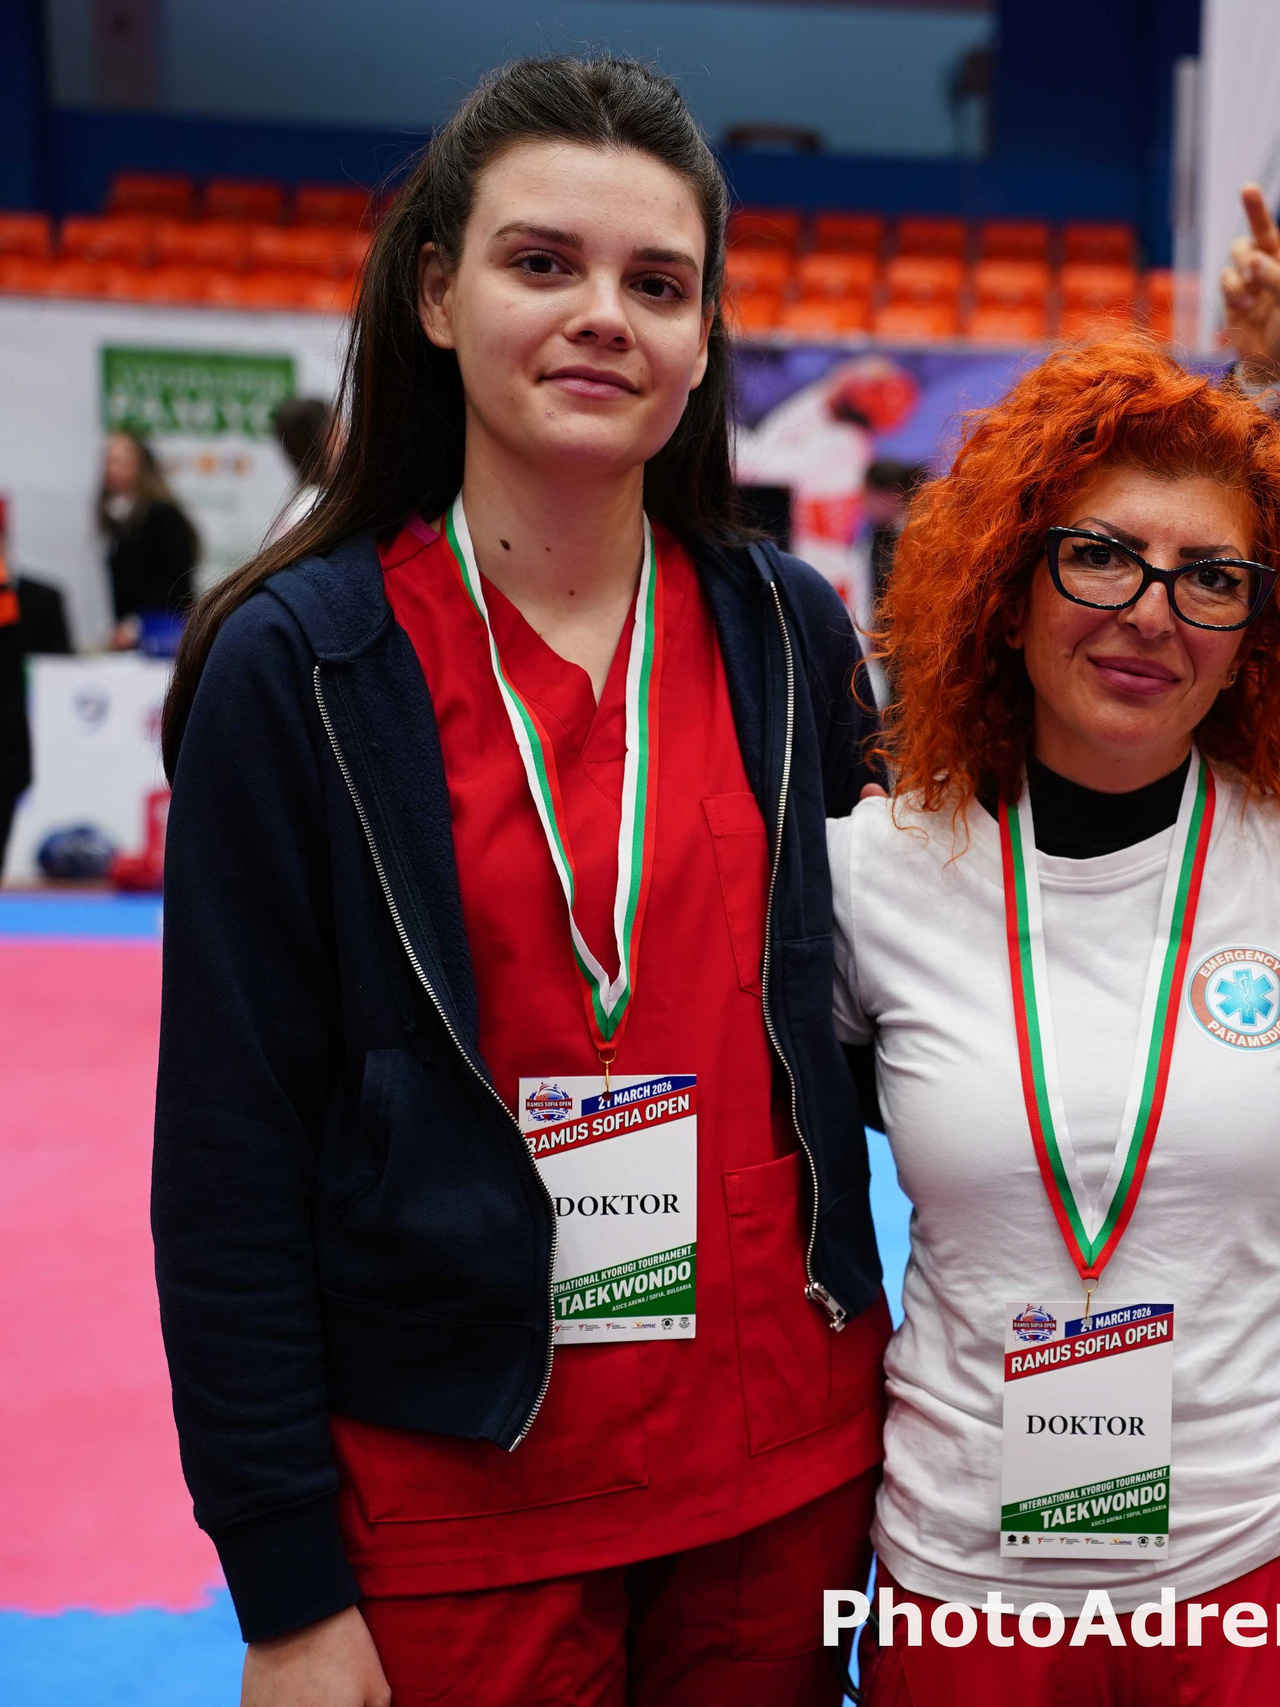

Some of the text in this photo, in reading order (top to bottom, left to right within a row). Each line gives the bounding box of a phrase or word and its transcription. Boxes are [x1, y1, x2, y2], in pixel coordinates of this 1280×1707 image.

[614, 1084, 650, 1106] MARCH
[652, 1081, 672, 1095] 2026
[528, 1094, 690, 1153] RAMUS SOFIA OPEN
[554, 1194, 680, 1217] DOKTOR
[553, 1245, 692, 1294] RNATIONAL KYORUGI TOURNAMENT
[558, 1261, 691, 1317] TAEKWONDO
[611, 1302, 628, 1312] ASICS
[628, 1297, 646, 1307] ARENA
[666, 1283, 692, 1296] BULGARIA
[1096, 1310, 1130, 1329] MARCH
[1132, 1307, 1151, 1320] 2026
[1011, 1320, 1168, 1374] RAMUS SOFIA OPEN
[1026, 1414, 1146, 1436] DOKTOR
[1019, 1467, 1168, 1512] INTERNATIONAL KYORUGI TOURNAMENT
[1040, 1482, 1167, 1529] TAEKWONDO
[1091, 1518, 1106, 1527] ASICS
[1106, 1514, 1122, 1524] ARENA
